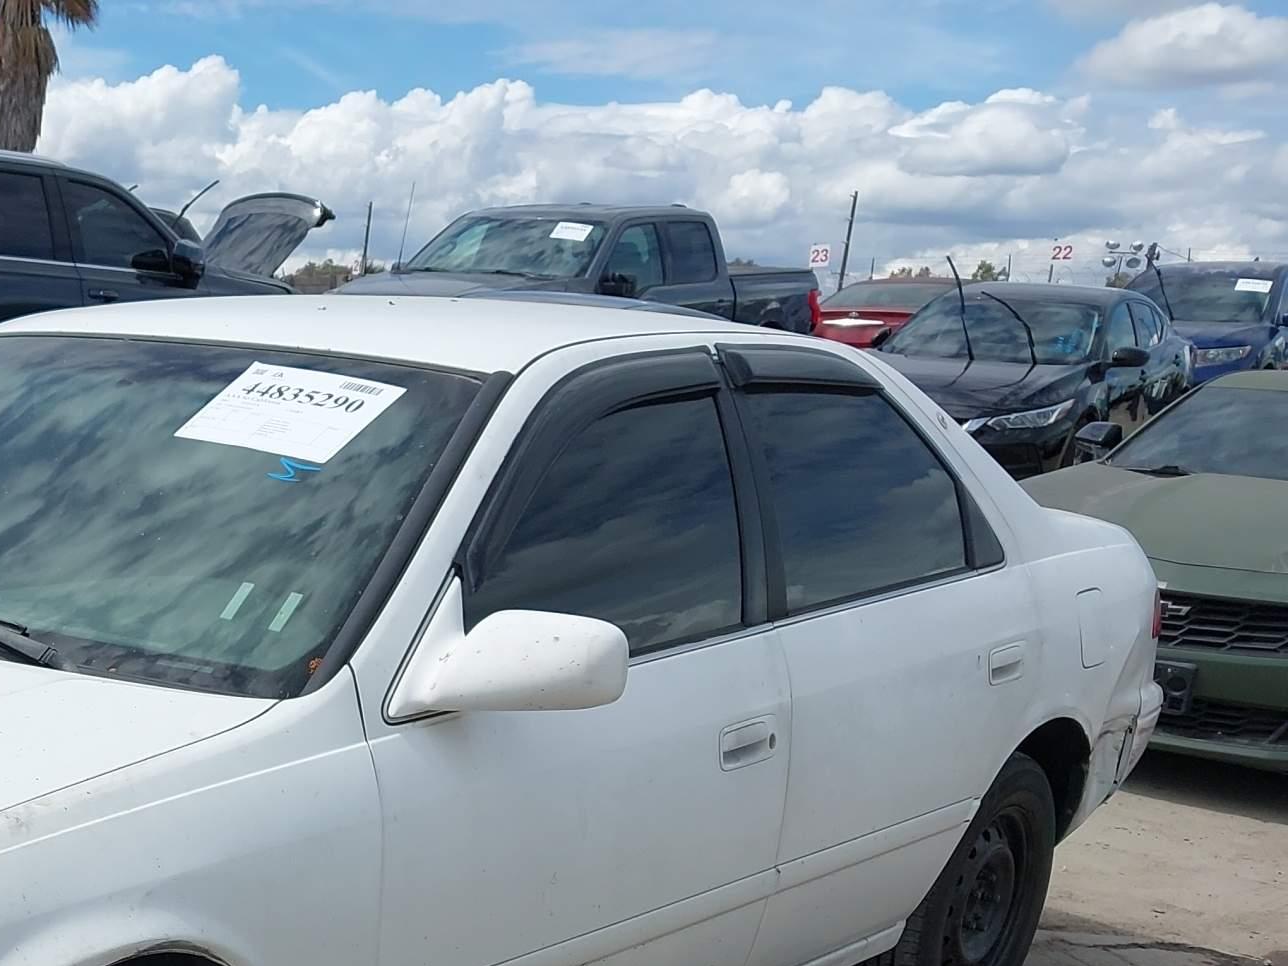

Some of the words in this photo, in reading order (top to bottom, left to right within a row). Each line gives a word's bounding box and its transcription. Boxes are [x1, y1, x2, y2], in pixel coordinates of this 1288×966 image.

[811, 248, 829, 263] 23
[1051, 245, 1073, 260] 22
[242, 382, 366, 414] 44835290
